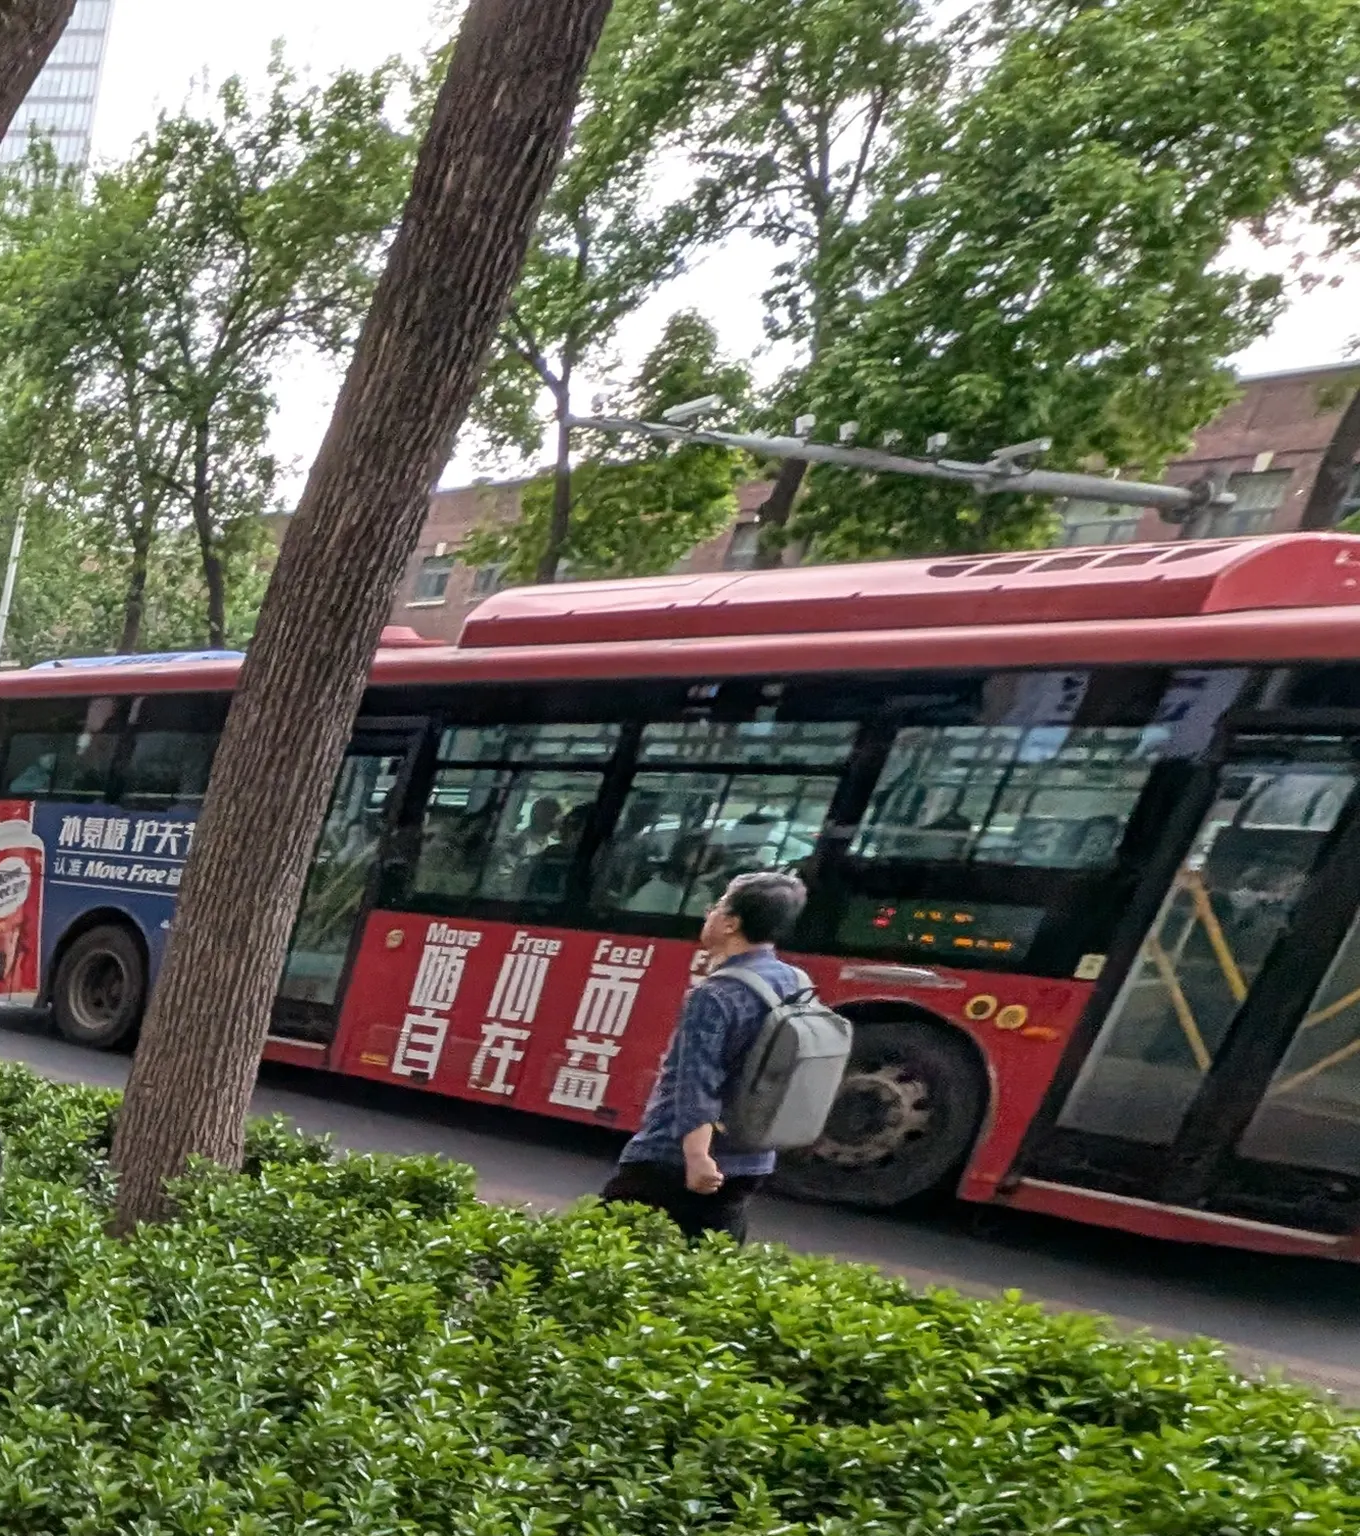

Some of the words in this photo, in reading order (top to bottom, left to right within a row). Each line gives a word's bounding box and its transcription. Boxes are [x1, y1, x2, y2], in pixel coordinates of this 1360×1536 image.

[83, 860, 128, 880] Move
[127, 864, 167, 884] Free
[426, 922, 482, 947] Move
[512, 931, 561, 956] Free
[594, 940, 655, 967] Feel
